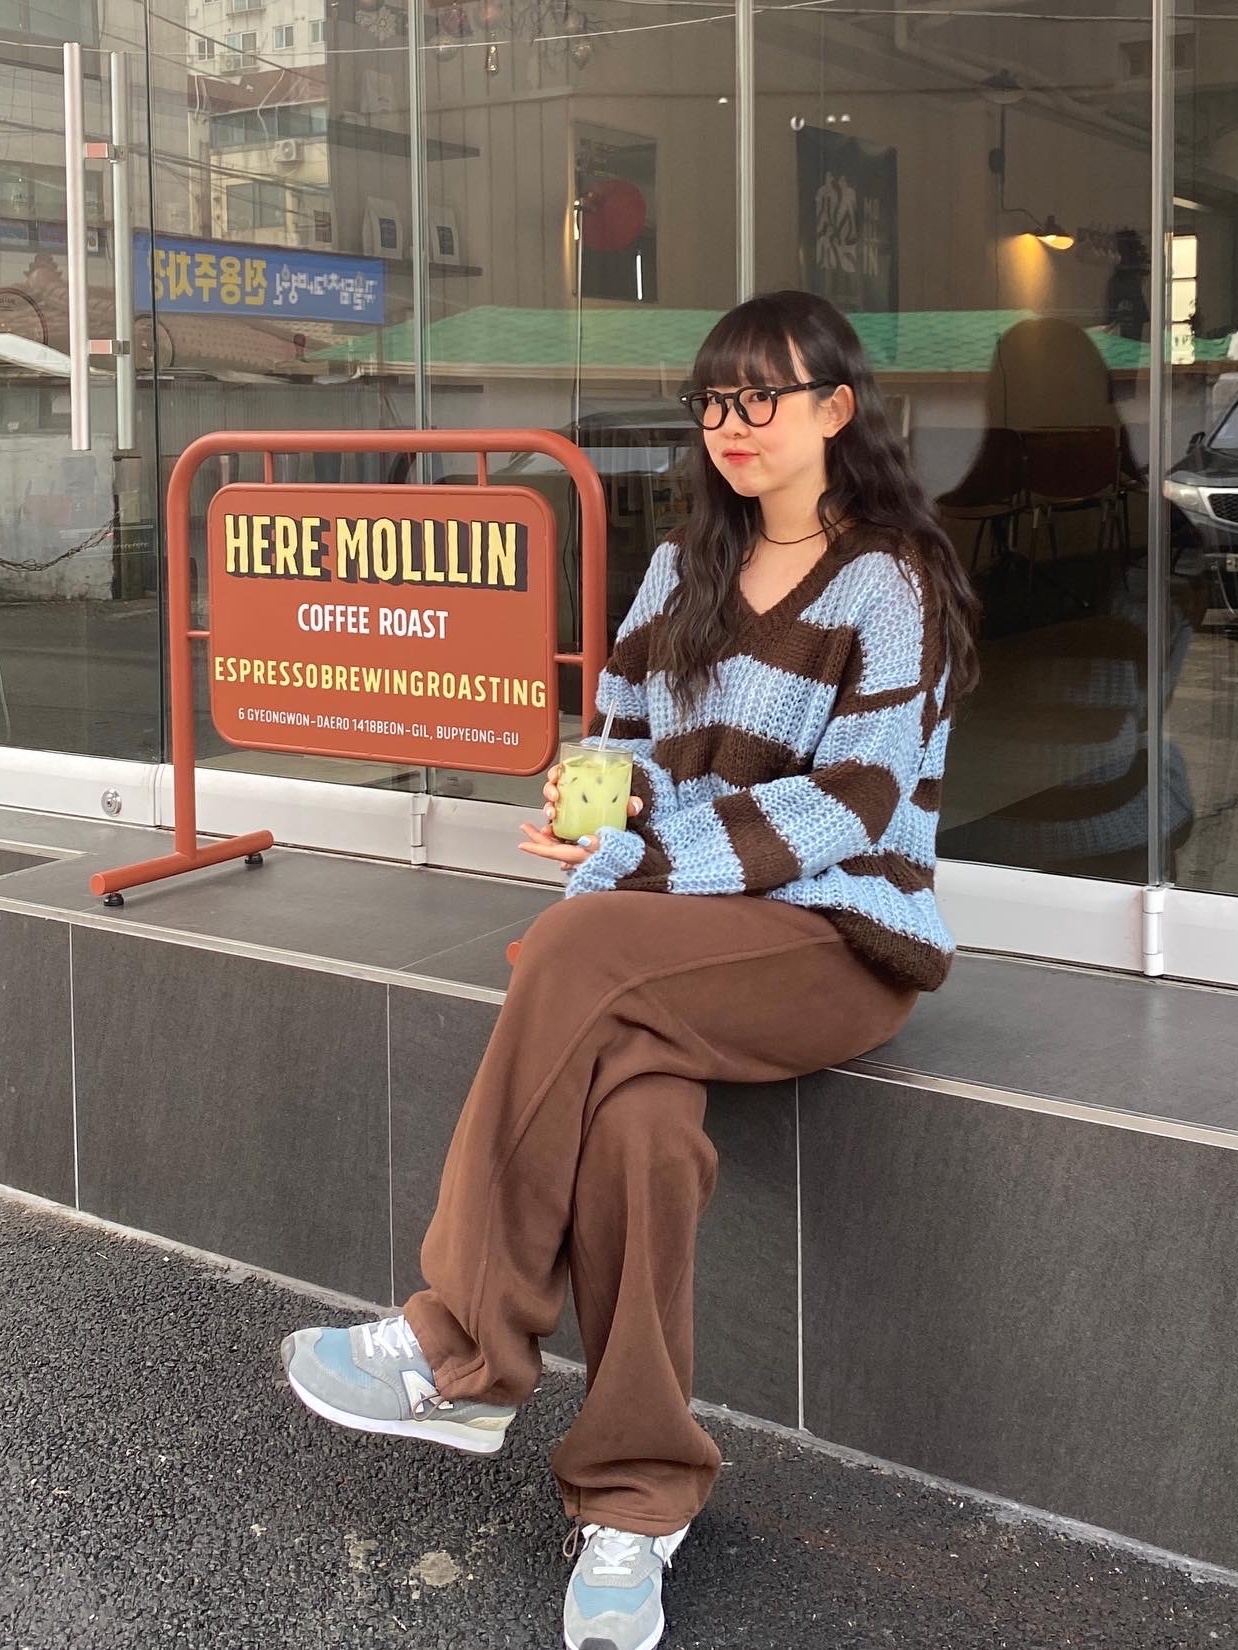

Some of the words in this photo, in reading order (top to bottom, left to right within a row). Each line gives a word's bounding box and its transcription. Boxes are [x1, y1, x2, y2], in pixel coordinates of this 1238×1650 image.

[225, 514, 322, 577] HERE
[336, 518, 517, 586] MOLLLIN
[298, 604, 370, 635] COFFEE
[379, 608, 449, 639] ROAST
[214, 656, 546, 708] ESPRESSOBREWINGROASTING
[238, 707, 245, 720] 6
[247, 708, 350, 731] GYEONGWON-DAERO
[351, 718, 433, 741] 1418BEON-GIL,
[436, 725, 519, 746] BUPYEONG-GU
